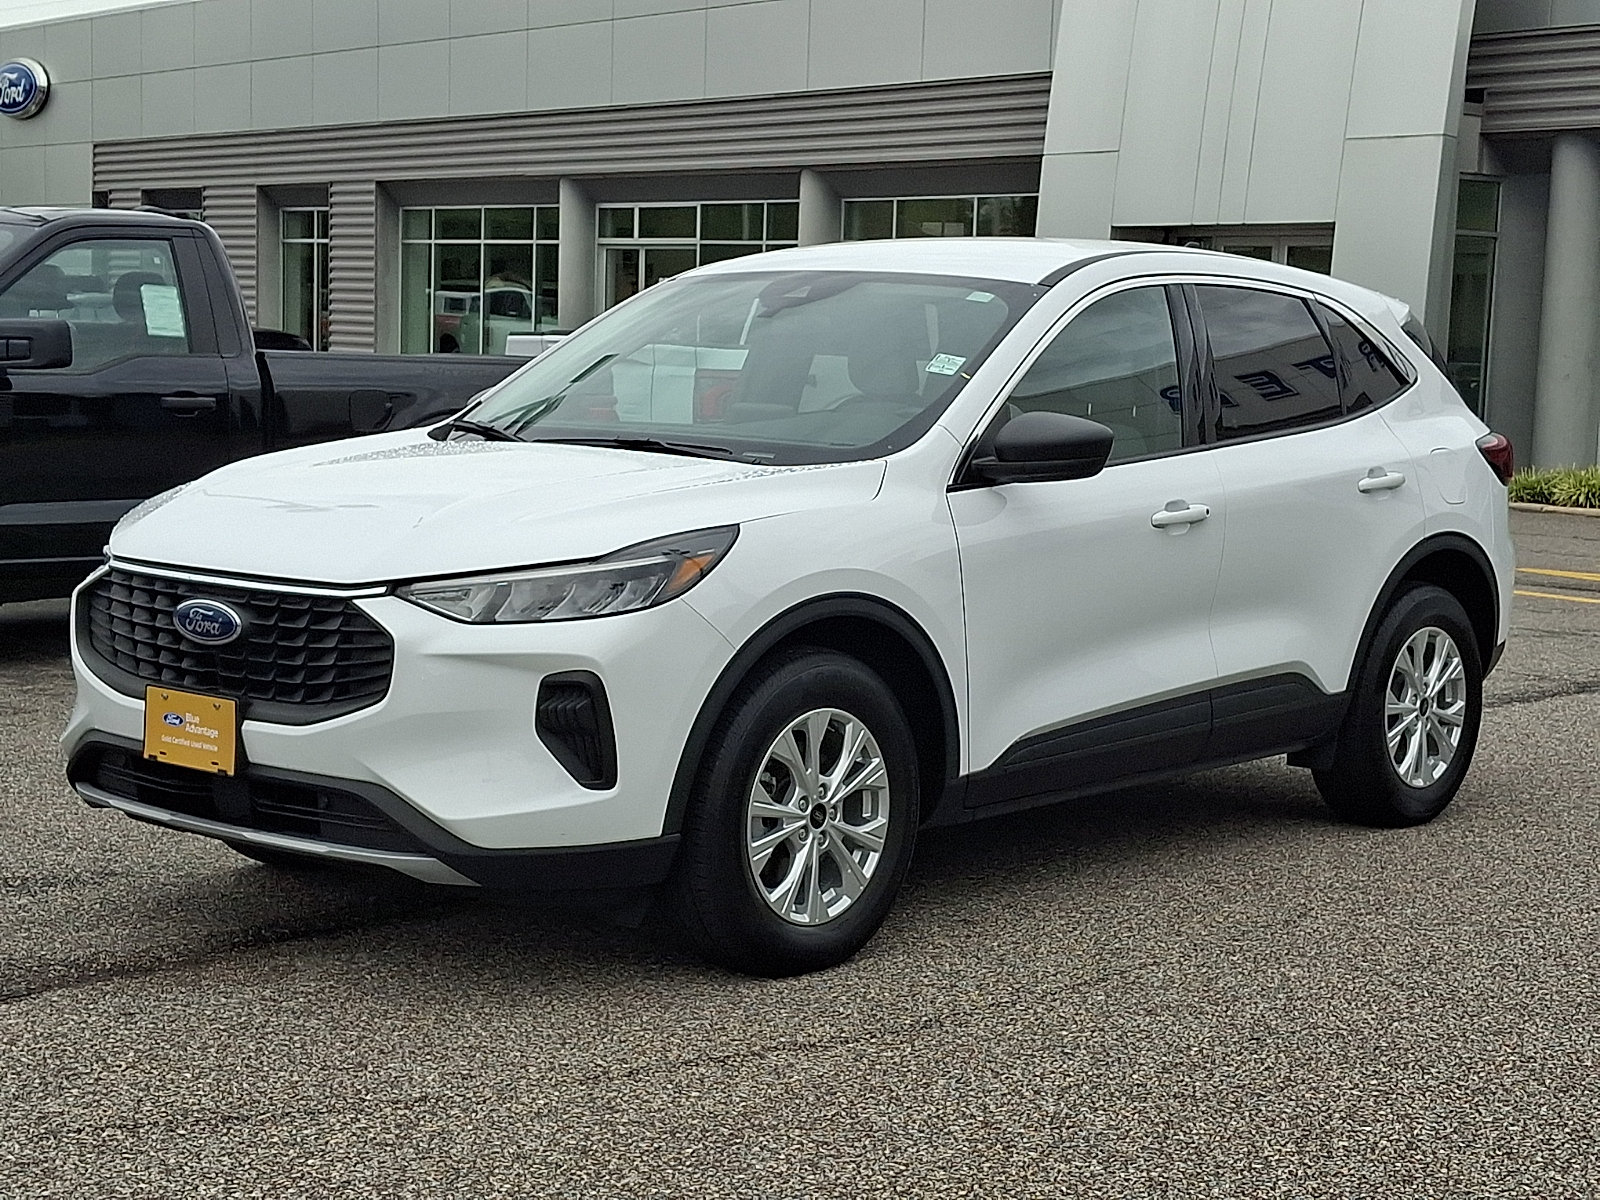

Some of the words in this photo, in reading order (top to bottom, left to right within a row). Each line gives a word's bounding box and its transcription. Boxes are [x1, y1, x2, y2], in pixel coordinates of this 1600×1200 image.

[0, 72, 26, 105] Ford
[185, 607, 222, 635] Ford
[166, 714, 181, 725] Ford
[185, 712, 200, 724] Blue
[185, 723, 219, 739] Advantage
[172, 737, 190, 746] Certified
